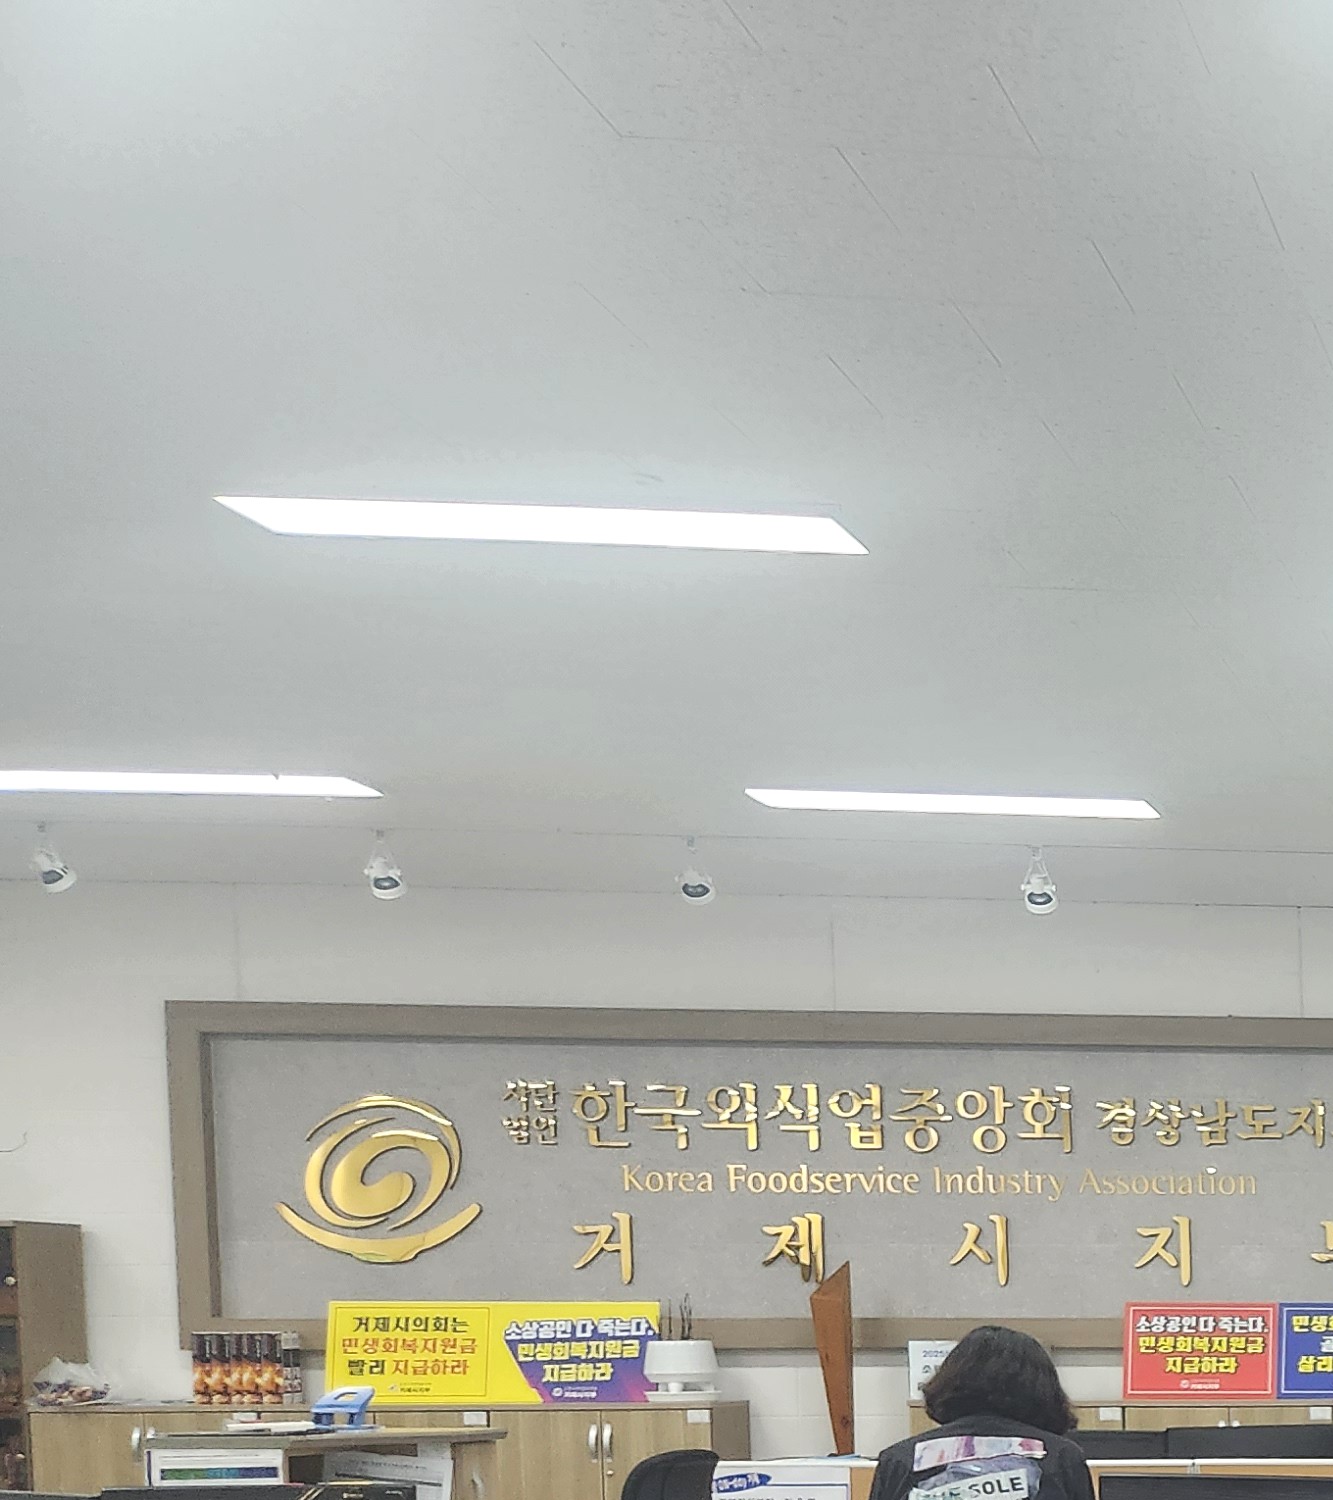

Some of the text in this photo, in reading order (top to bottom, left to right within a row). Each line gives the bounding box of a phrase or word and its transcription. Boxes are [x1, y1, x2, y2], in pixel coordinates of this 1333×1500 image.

[569, 1080, 1074, 1153] 한국외식업중앙회
[622, 1163, 1257, 1202] Korea Foodservice Industry Association
[352, 1316, 469, 1333] 거제시의회는
[505, 1321, 571, 1340] 소상공인
[576, 1320, 594, 1338] 다
[1136, 1316, 1198, 1333] 소상공인
[342, 1337, 477, 1355] 민생회복지원금
[517, 1340, 640, 1361] 민생회복지원금
[1138, 1336, 1265, 1353] 민생회복지원금
[348, 1359, 469, 1376] 빨리 지급하라
[542, 1363, 614, 1383] 지급하라
[1165, 1356, 1238, 1373] 지급하라
[968, 1476, 1024, 1499] SOLE
